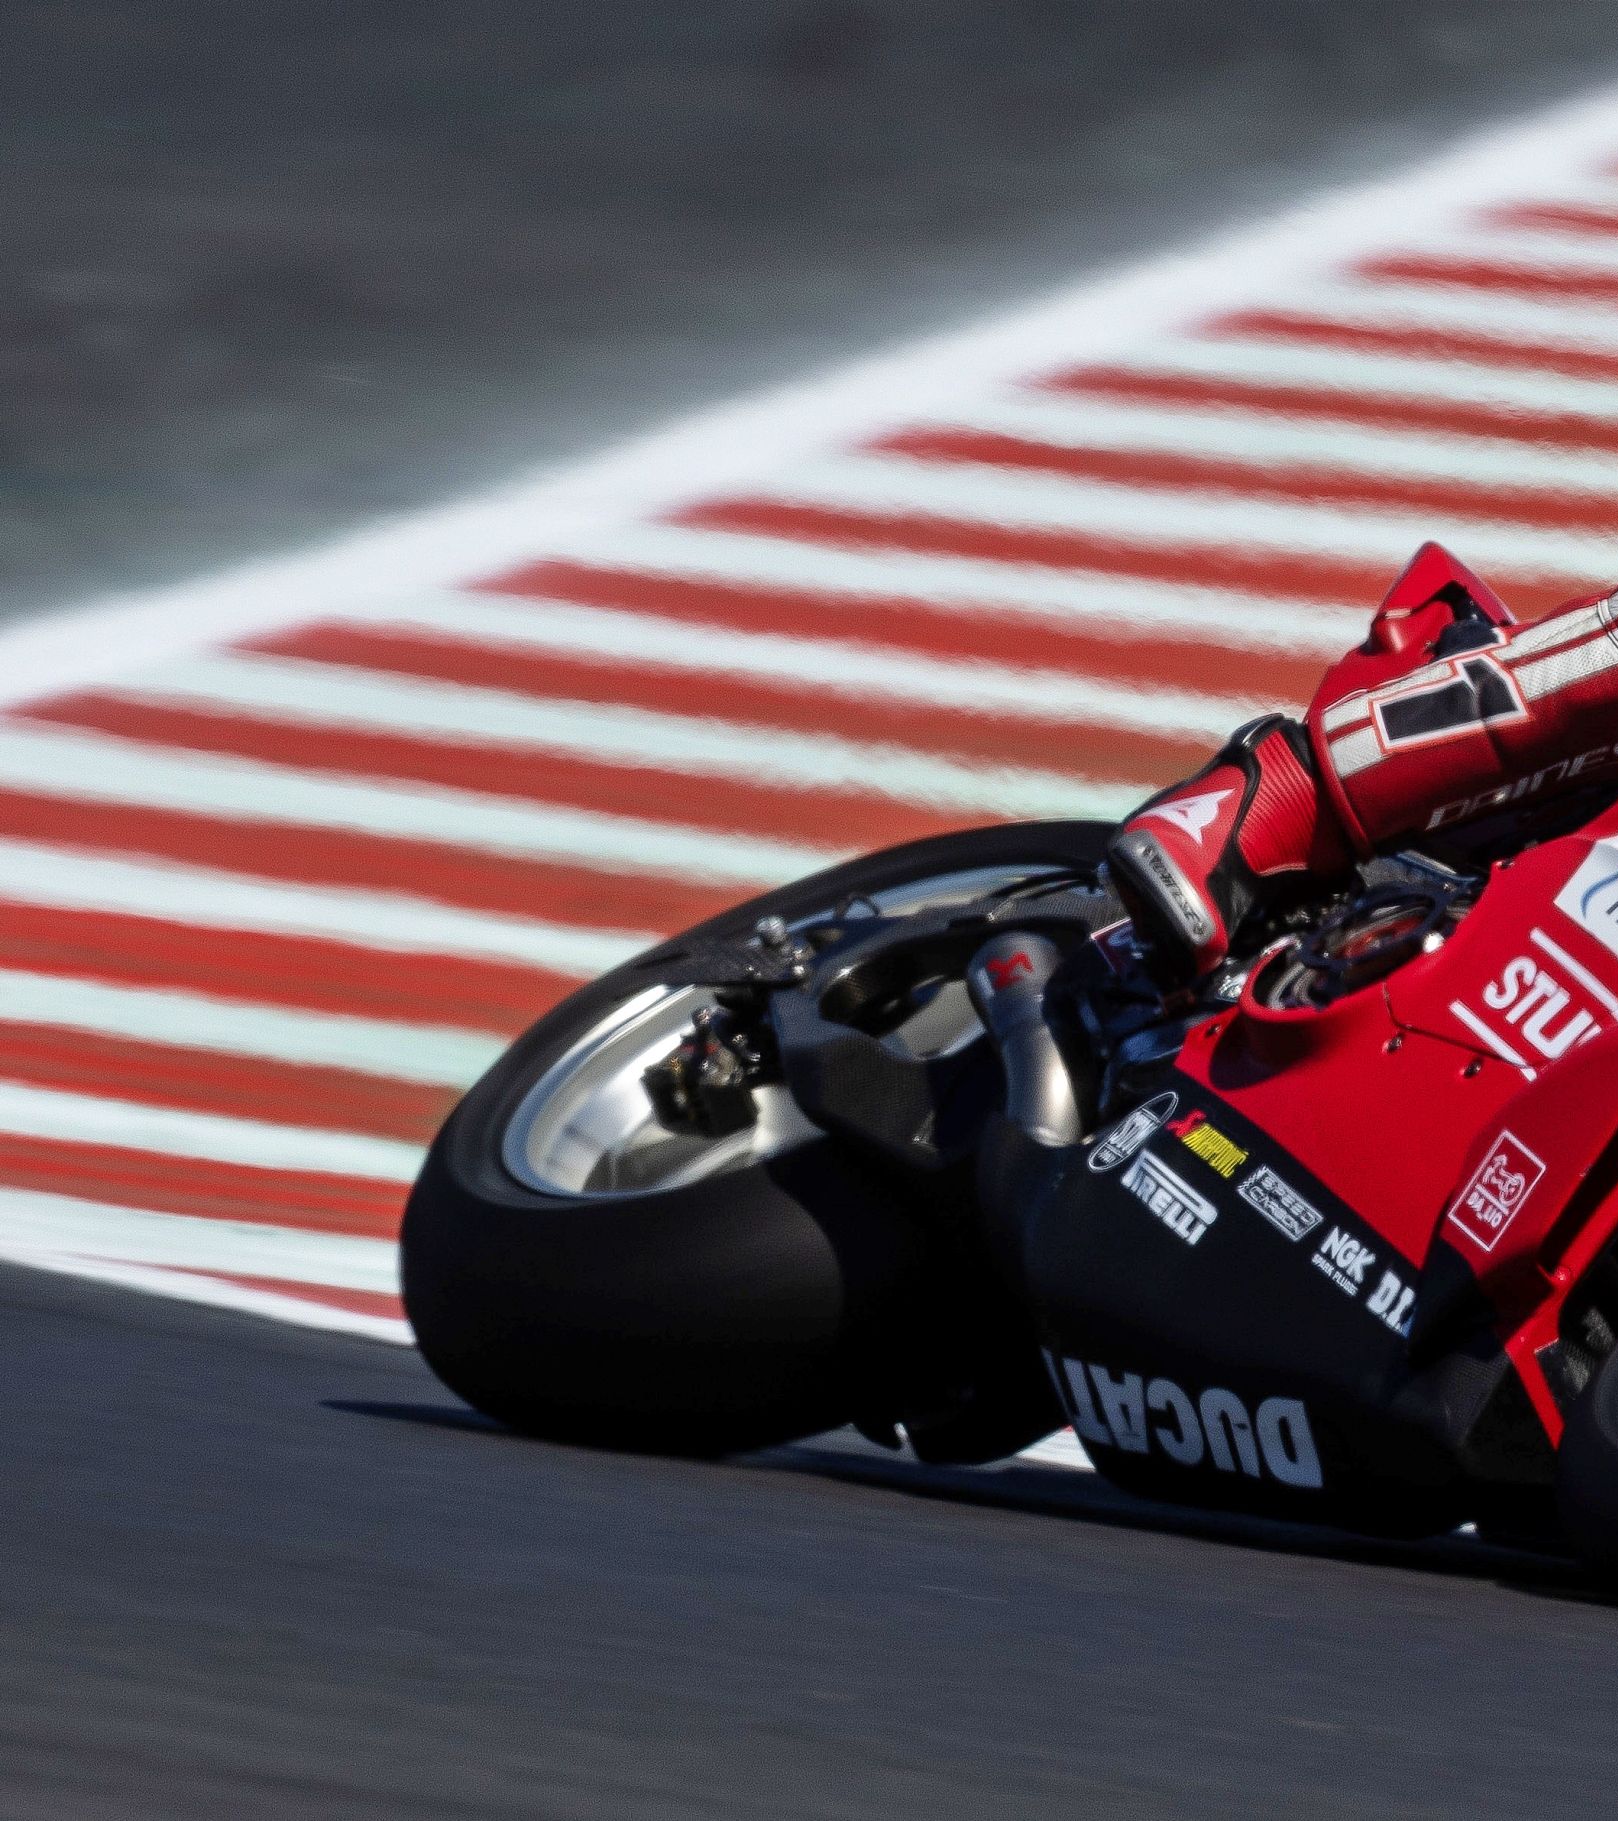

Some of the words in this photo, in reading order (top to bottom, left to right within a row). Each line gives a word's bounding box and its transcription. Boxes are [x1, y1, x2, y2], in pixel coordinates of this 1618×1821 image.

[1482, 955, 1602, 1060] STU
[1120, 1149, 1219, 1245] PIRELLI
[1311, 1253, 1335, 1278] SPARK
[1320, 1225, 1376, 1285] NGK
